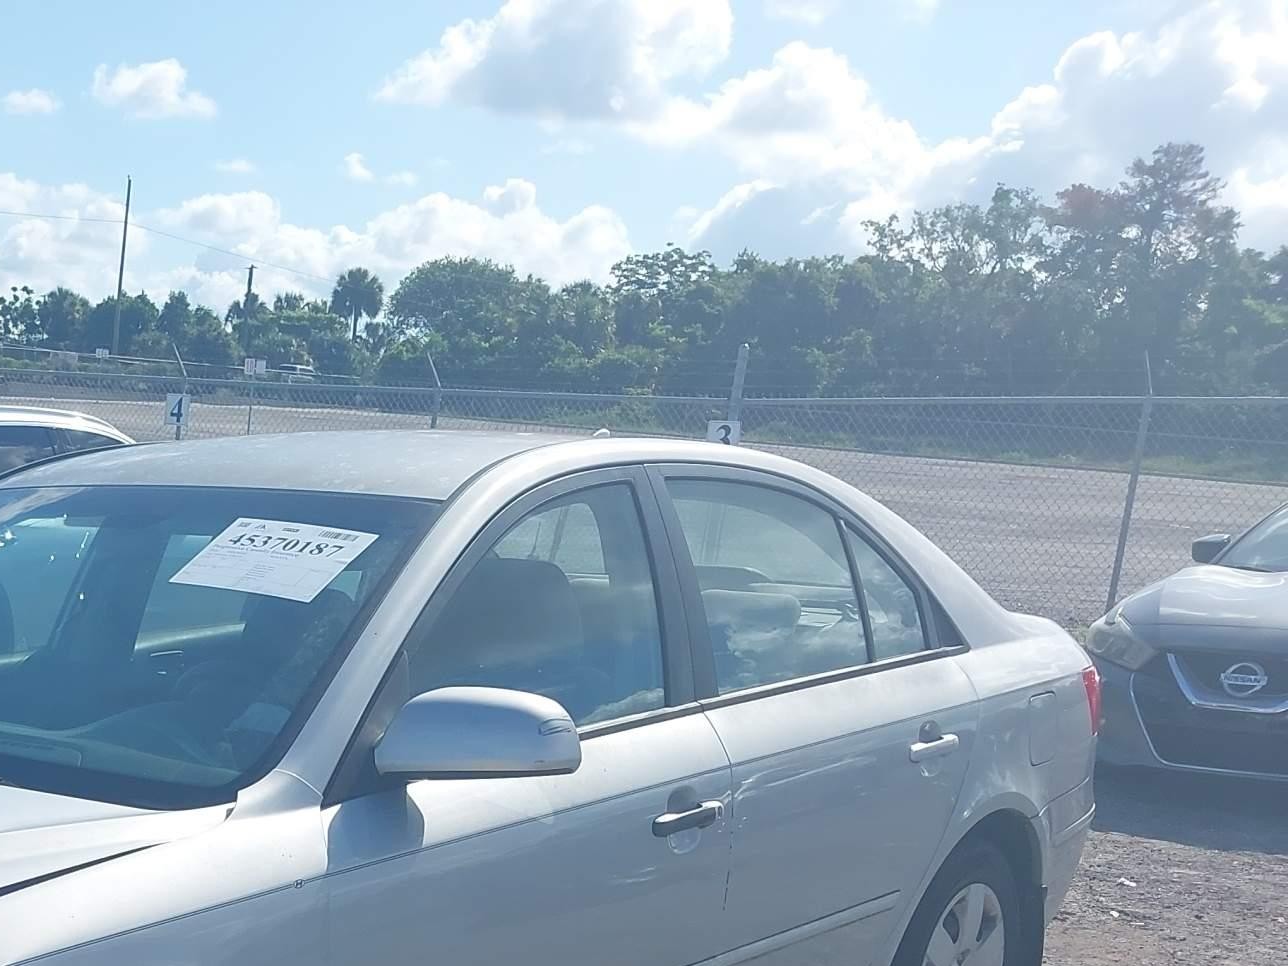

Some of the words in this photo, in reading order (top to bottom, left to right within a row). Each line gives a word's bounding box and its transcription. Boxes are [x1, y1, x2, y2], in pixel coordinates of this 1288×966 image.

[170, 396, 184, 423] 4
[715, 424, 732, 446] 3
[228, 532, 345, 558] 45370187
